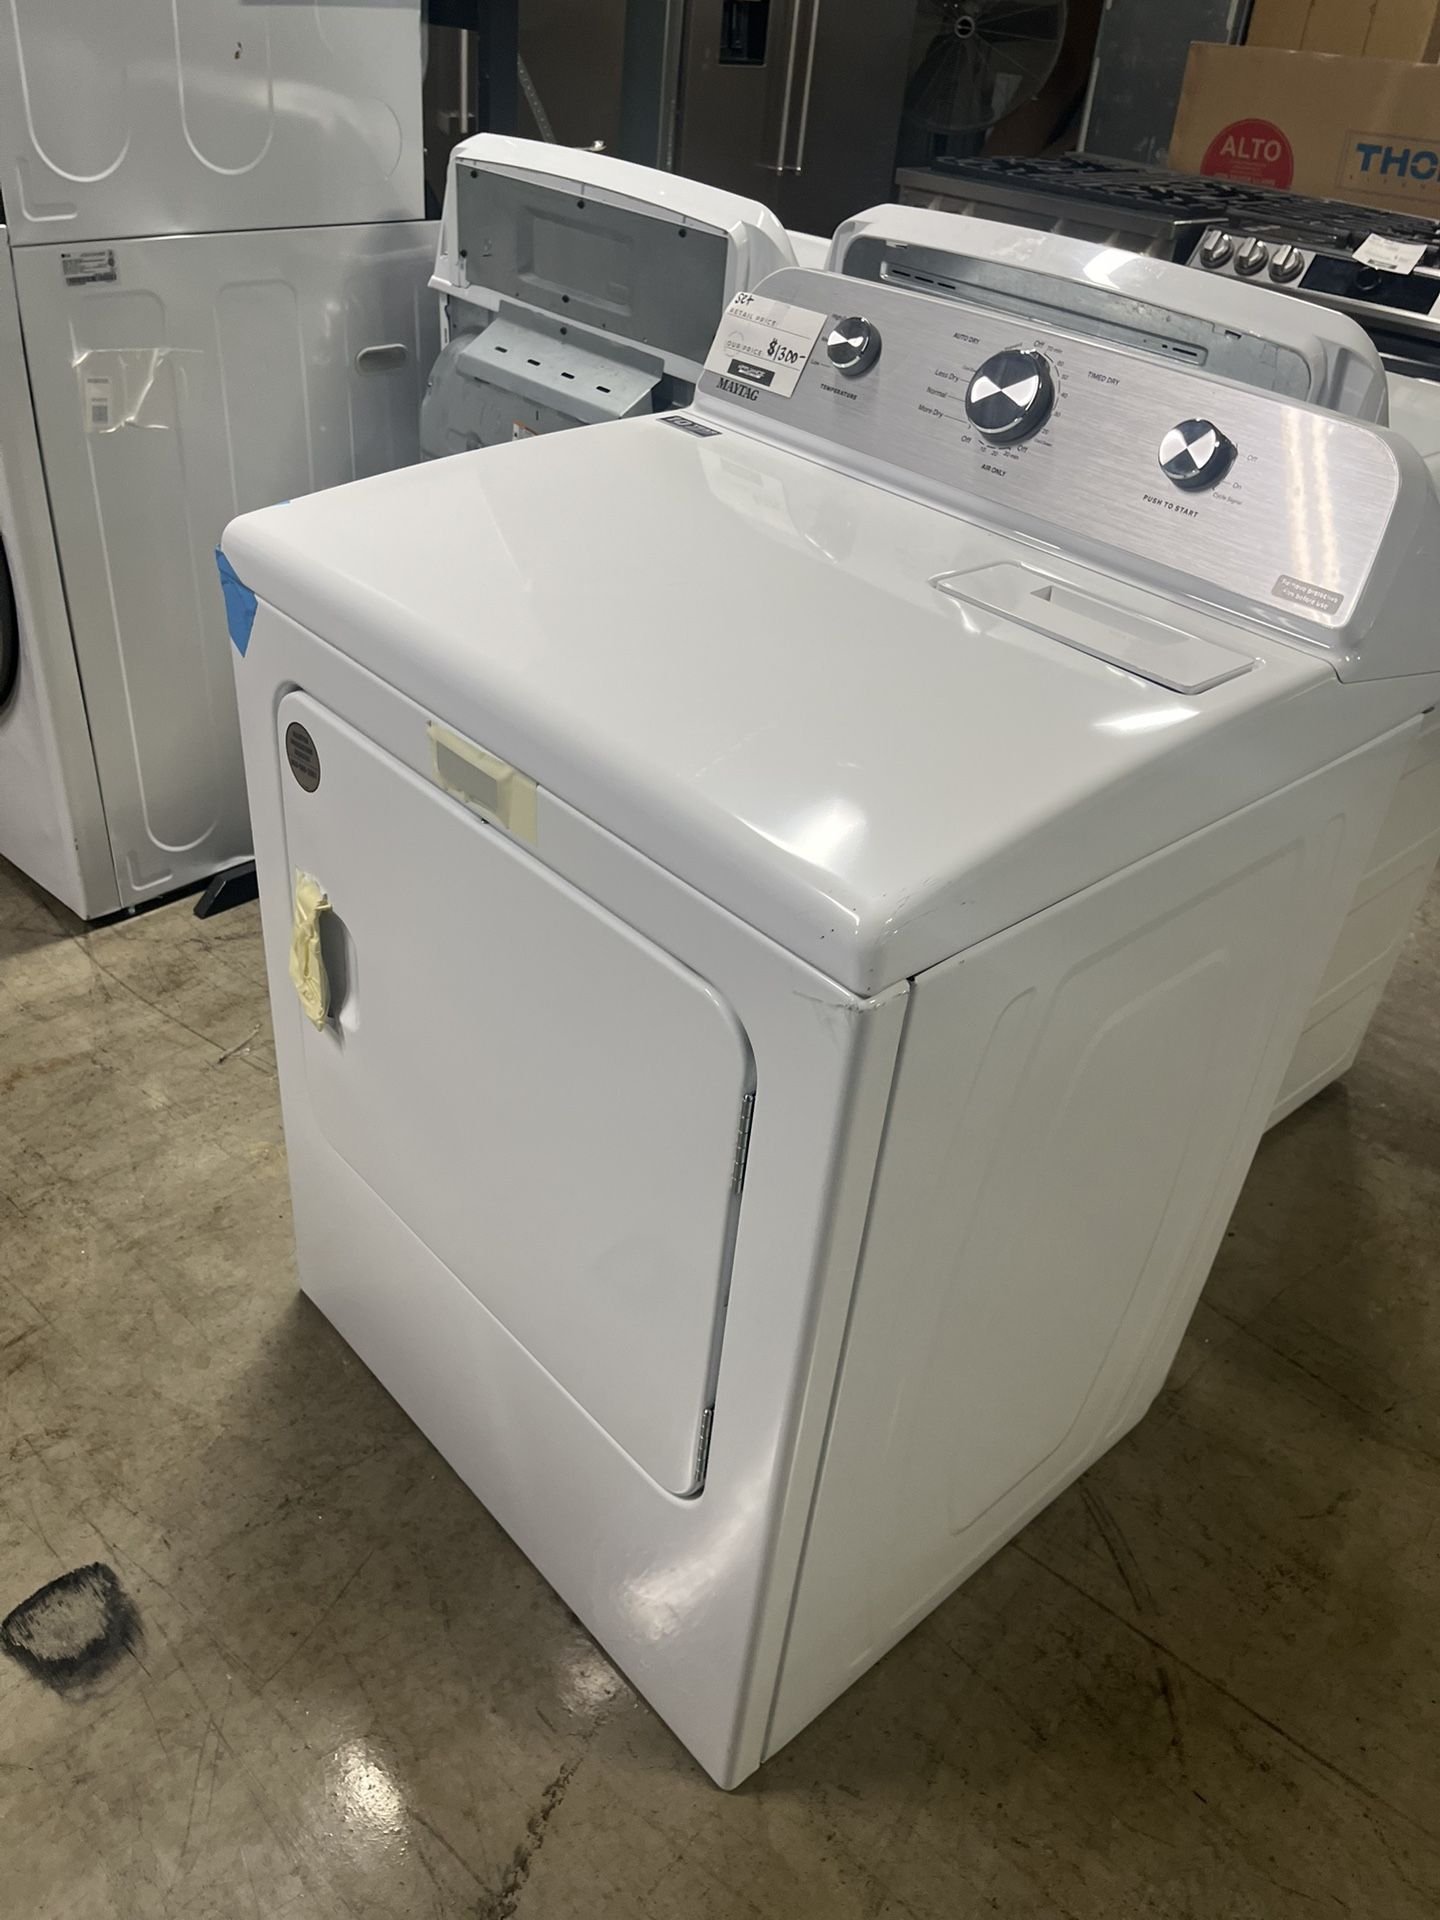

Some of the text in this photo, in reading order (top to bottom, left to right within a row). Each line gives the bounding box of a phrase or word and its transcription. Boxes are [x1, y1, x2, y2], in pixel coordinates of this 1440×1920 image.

[1220, 135, 1282, 162] ALTO
[1356, 143, 1440, 183] THO
[729, 307, 753, 320] RETAIL
[953, 332, 980, 345] AUTO DRY
[1033, 340, 1045, 349] Off
[935, 369, 959, 383] Less Dry
[1088, 370, 1120, 385] TIMED DRY
[716, 377, 760, 401] MAYTAG
[820, 383, 858, 400] TEMPERATURE
[927, 386, 948, 398] Normal
[918, 404, 944, 419] More Dry
[961, 435, 972, 444] Off
[981, 463, 1007, 477] AIR ONLY
[1142, 494, 1199, 517] PUSH TO START
